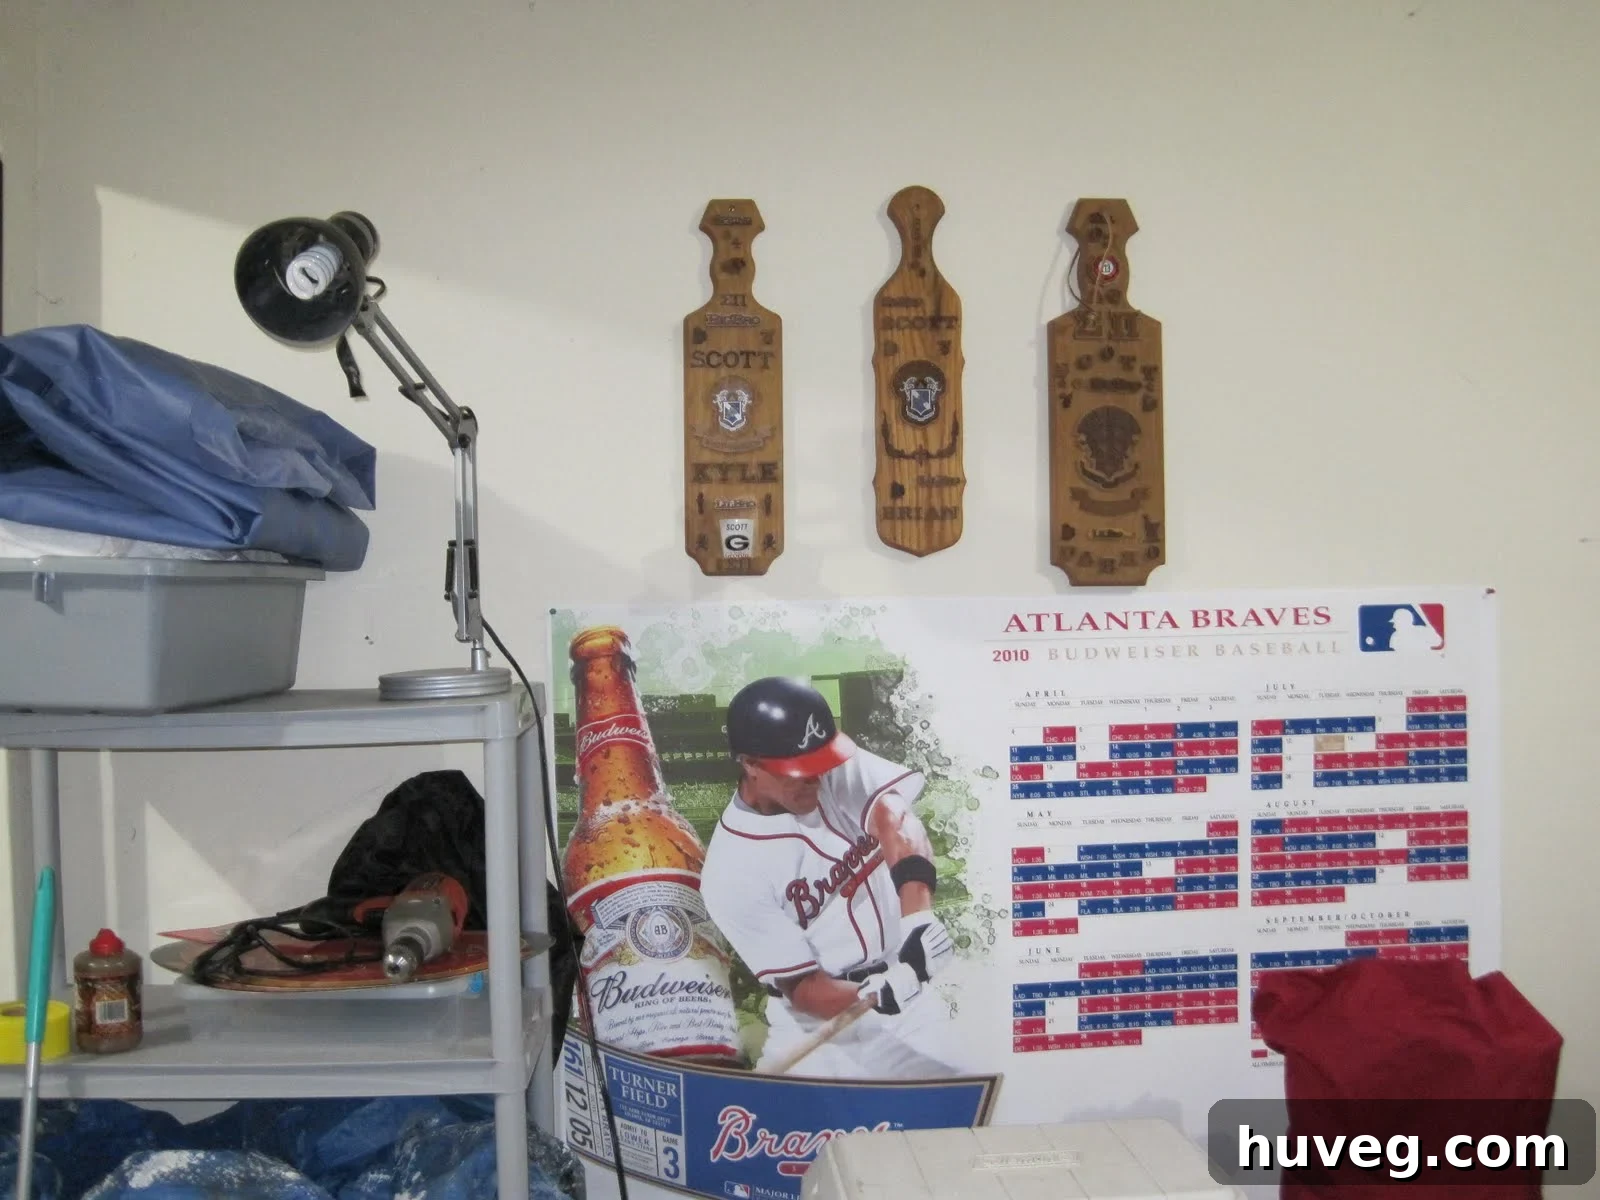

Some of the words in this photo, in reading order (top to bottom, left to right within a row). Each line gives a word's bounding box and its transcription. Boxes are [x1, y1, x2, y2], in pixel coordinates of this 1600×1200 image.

[690, 351, 774, 369] SCOTT
[692, 462, 778, 484] KYLE
[882, 506, 959, 520] BRIAN
[725, 535, 749, 551] G
[1003, 610, 1180, 633] ATLANTA
[1190, 606, 1331, 628] BRAVES
[992, 649, 1029, 662] 2010
[1048, 644, 1199, 661] BUDWEISER
[1215, 641, 1341, 657] BASEBALL
[1026, 690, 1065, 698] APRIL
[1266, 683, 1295, 692] JULY
[798, 713, 826, 748] A
[1266, 800, 1316, 808] AUGUST
[1027, 810, 1052, 818] MAY
[1028, 947, 1060, 956] JUNE
[590, 971, 731, 1014] Budweiser
[634, 1000, 659, 1009] KING
[609, 1066, 678, 1098] TURNER
[565, 1081, 588, 1111] 12
[621, 1085, 667, 1109] FIELD
[569, 1117, 593, 1149] 05
[662, 1136, 678, 1145] GAME
[663, 1146, 680, 1179] 3
[755, 1187, 788, 1199] MAJOR
